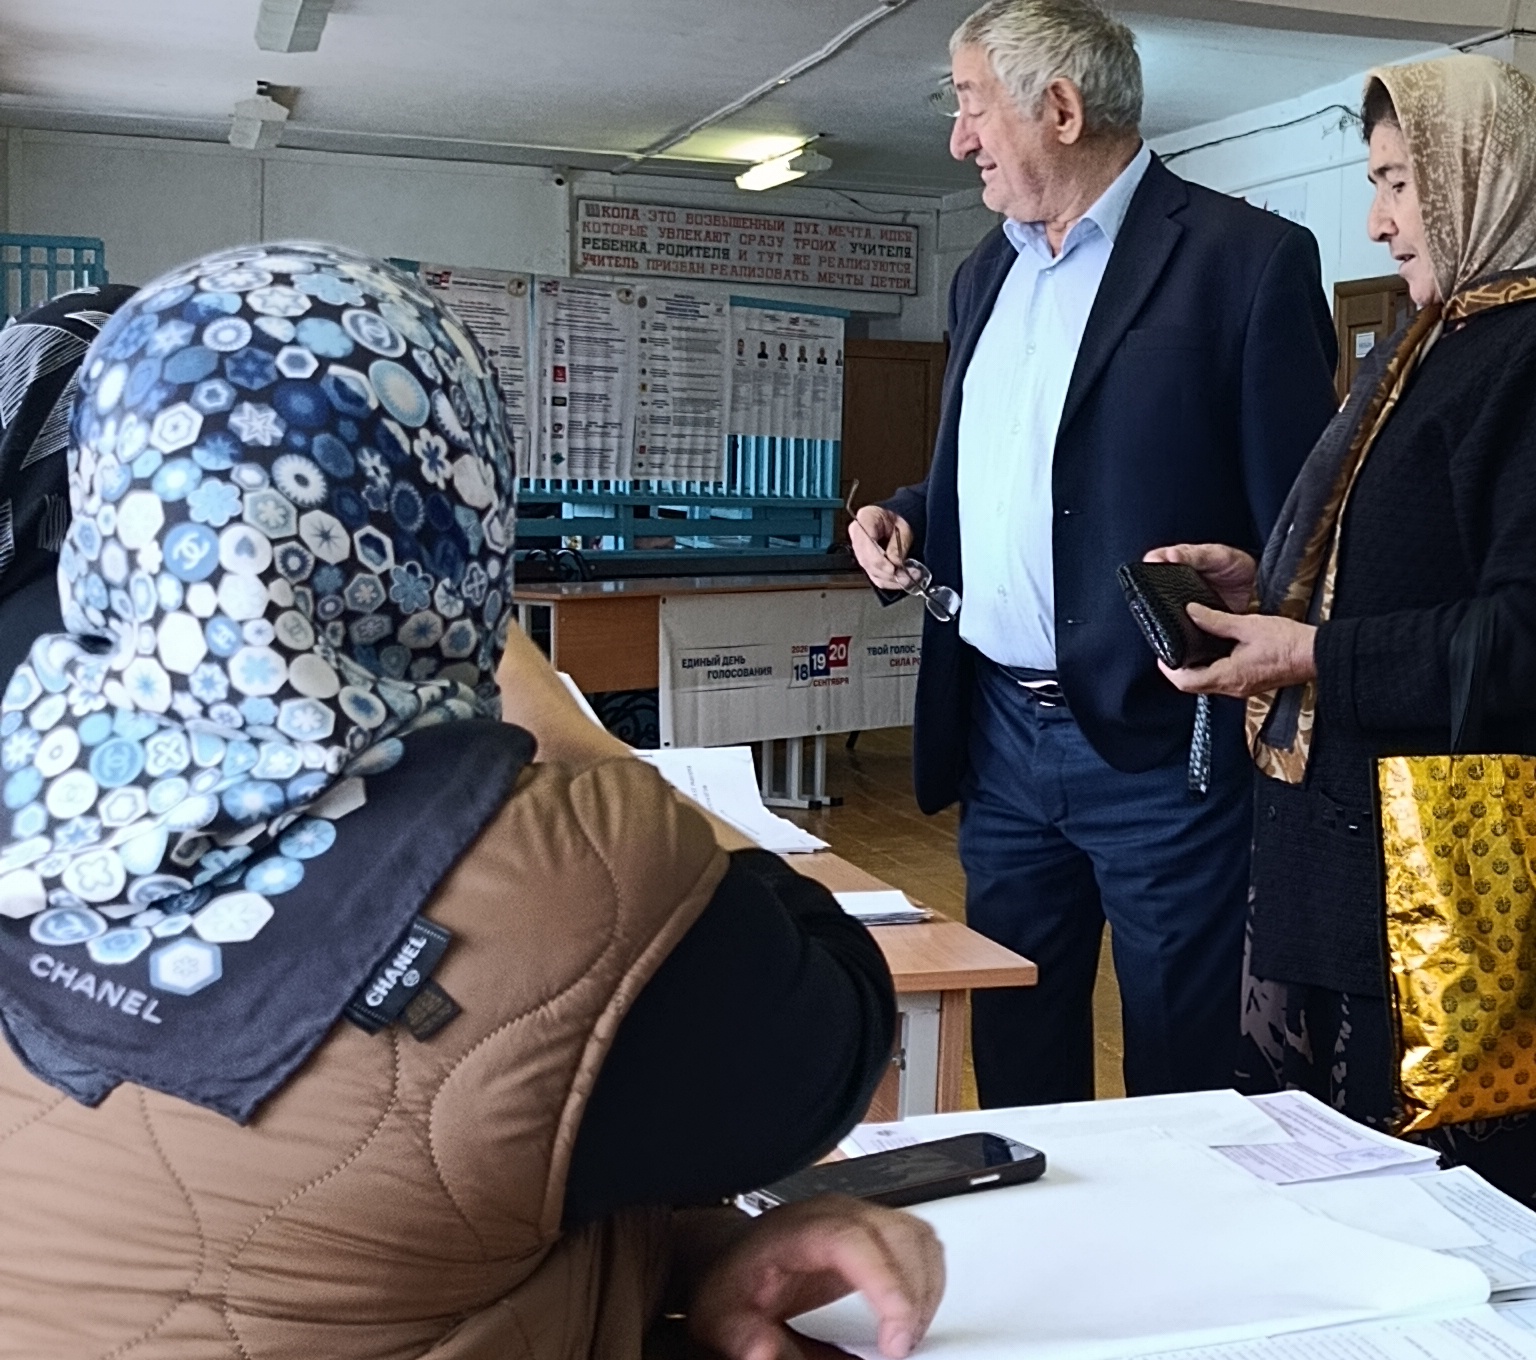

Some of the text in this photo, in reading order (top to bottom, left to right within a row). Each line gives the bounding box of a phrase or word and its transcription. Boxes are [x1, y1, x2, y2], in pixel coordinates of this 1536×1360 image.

[585, 203, 640, 220] ШКОЛА
[648, 209, 676, 224] ЭТО
[686, 212, 785, 232] ВОЗВЫШЕННЫЙ
[582, 221, 648, 237] КОТОРЫЕ
[658, 226, 731, 244] УВЛЕКАЮТ
[739, 233, 784, 246] СРАЗУ
[793, 238, 836, 252] ТРОИХ
[657, 242, 731, 260] РОДИТЕЛЯ
[738, 249, 747, 261] И
[757, 251, 783, 263] ТУТ
[793, 253, 811, 266] ЖЕ
[582, 252, 911, 289] УЧИТЕЛЬ ПРИЗВАН РЕАЛИЗОВАТЬ МЕЧТЫ ДЕТЕЙ
[681, 654, 746, 669] ЕДИНЫЙ ДЕНЬ
[793, 643, 847, 682] 18 19 20
[867, 644, 889, 656] ТВОЙ
[890, 644, 915, 655] ГОЛОС
[890, 657, 911, 667] СИЛА
[707, 666, 773, 680] ГОЛОСОВАНИЯ
[813, 677, 849, 687] СЕНТЯБРЯ
[365, 936, 427, 1007] CHANEL
[29, 953, 162, 1024] CHANEL
